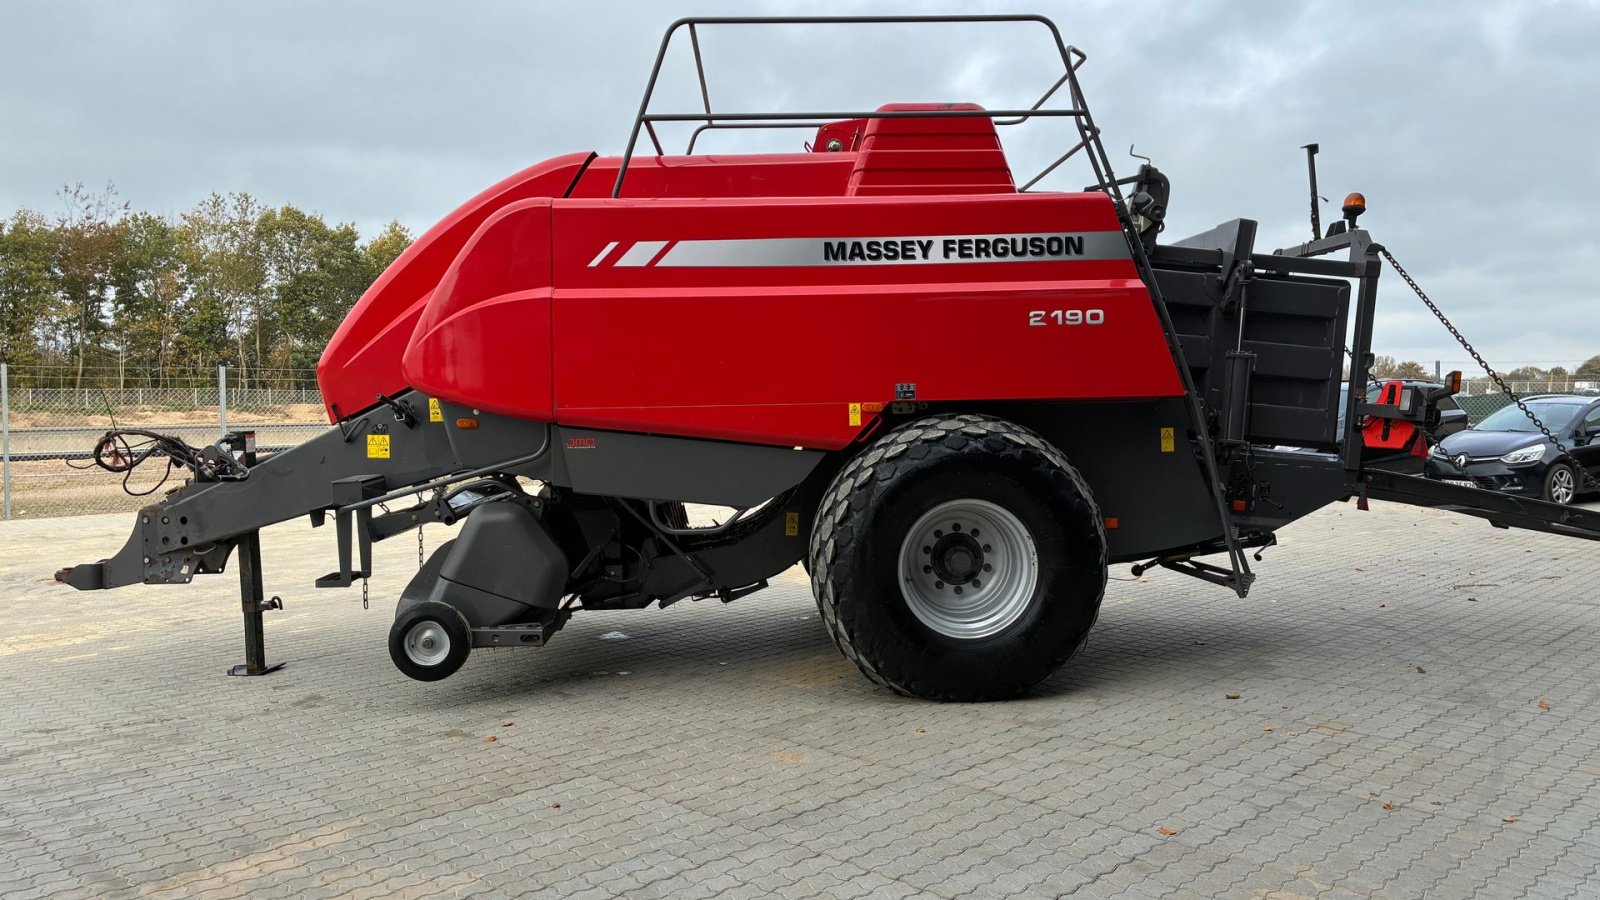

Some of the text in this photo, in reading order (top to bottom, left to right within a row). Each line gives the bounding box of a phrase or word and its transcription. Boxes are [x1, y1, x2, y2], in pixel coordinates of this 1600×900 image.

[824, 236, 1084, 262] MASSEY FERGUSON
[1028, 309, 1105, 326] 2190
